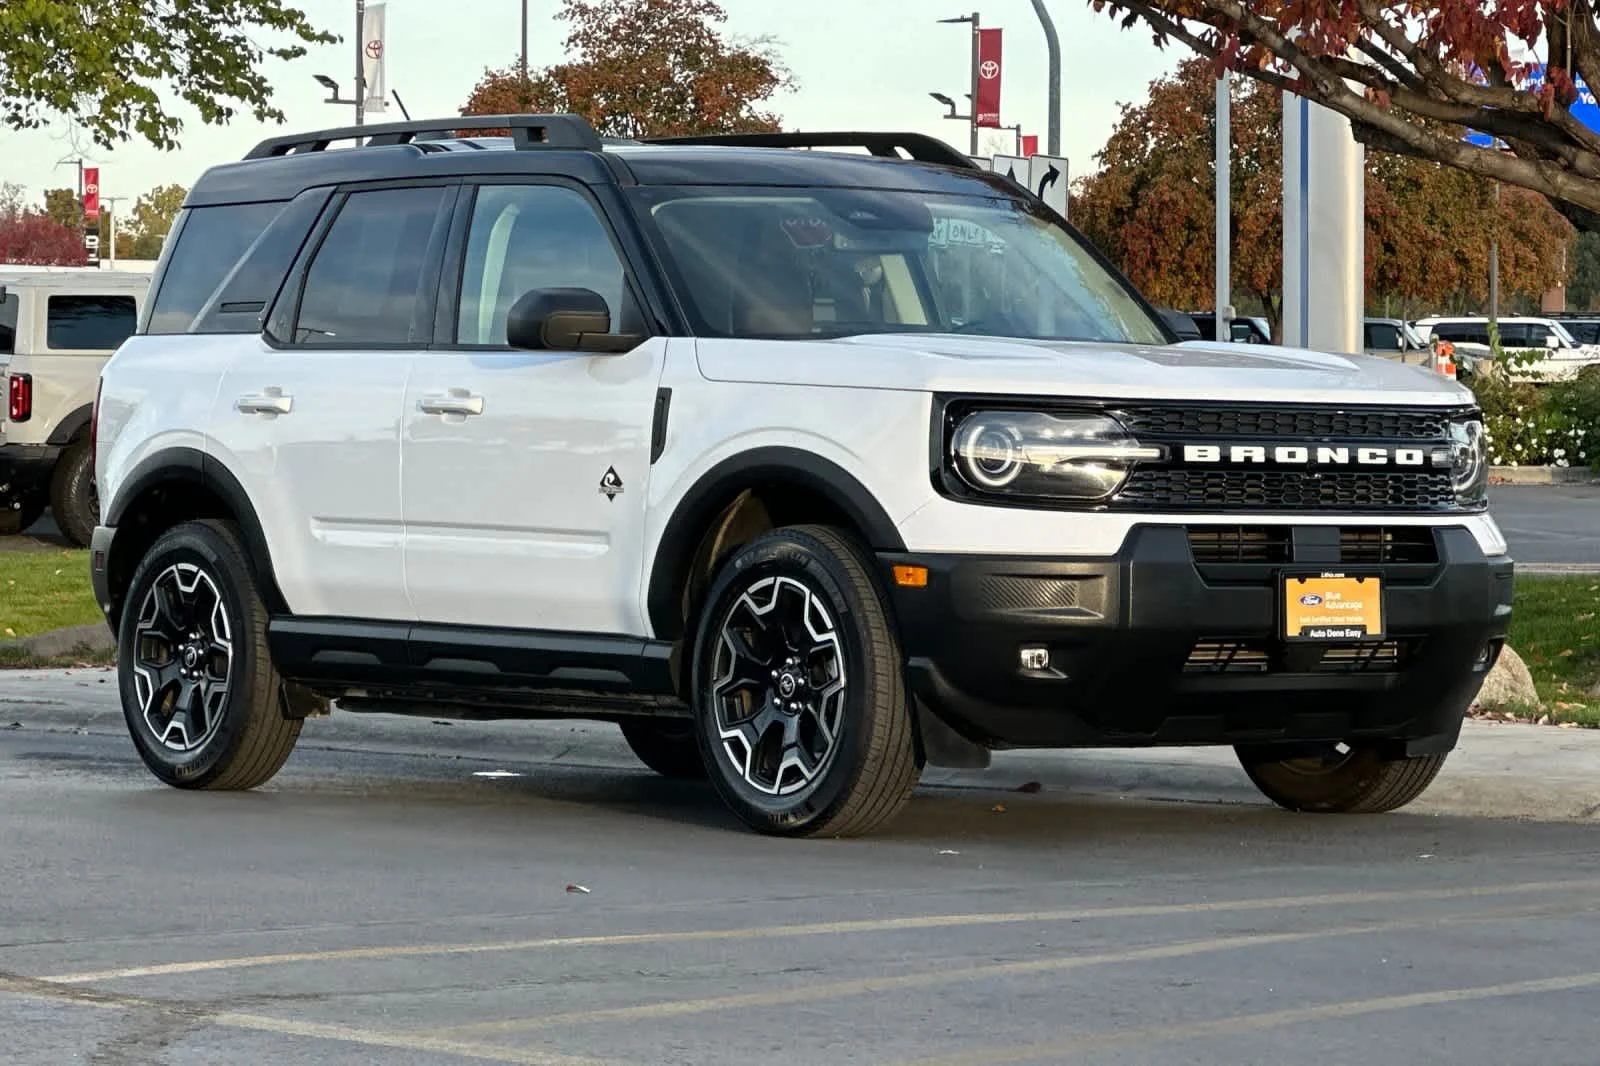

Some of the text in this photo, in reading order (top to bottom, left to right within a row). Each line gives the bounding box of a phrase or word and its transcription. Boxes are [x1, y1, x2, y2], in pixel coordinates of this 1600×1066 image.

[1184, 445, 1423, 465] BRONCO
[1325, 600, 1363, 611] Advantage
[1327, 629, 1344, 637] Done
[1346, 629, 1362, 638] Easy
